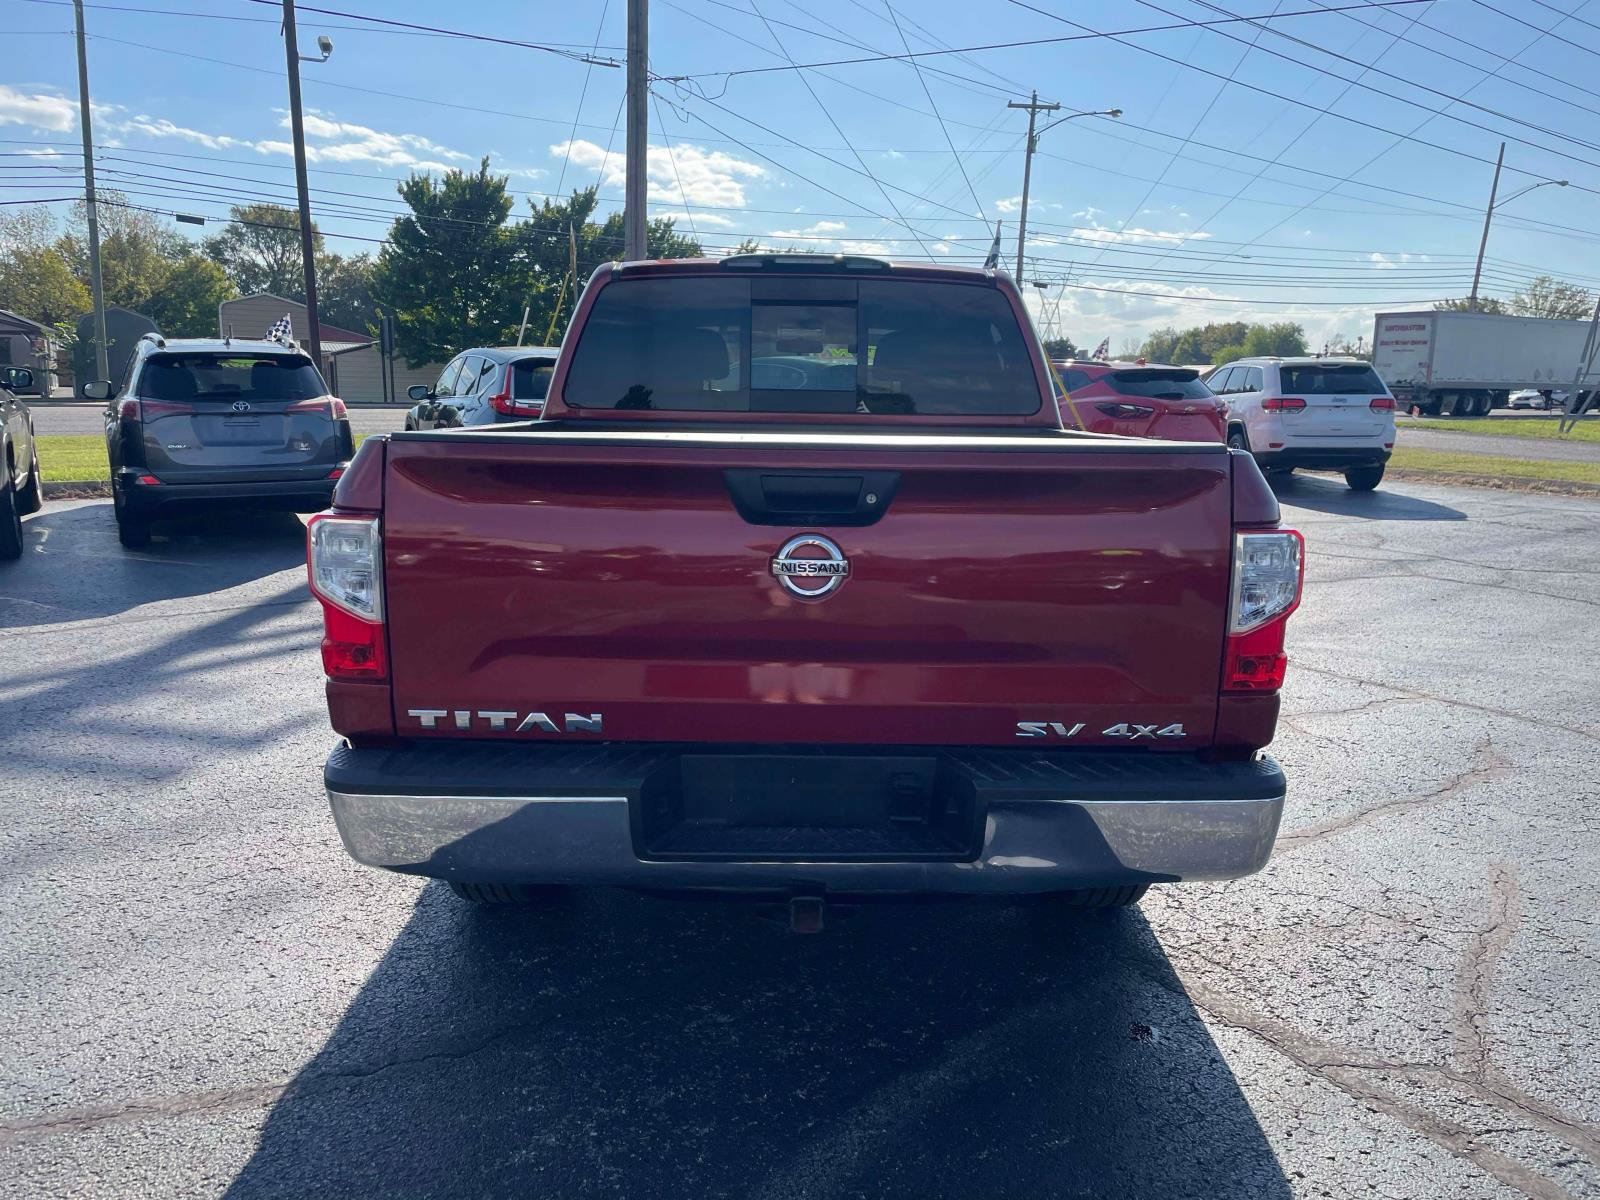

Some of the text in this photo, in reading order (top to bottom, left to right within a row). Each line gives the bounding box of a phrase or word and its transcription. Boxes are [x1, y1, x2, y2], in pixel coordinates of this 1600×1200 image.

[780, 562, 840, 575] NISSAN
[407, 709, 603, 733] TITAN
[1015, 721, 1086, 737] SV
